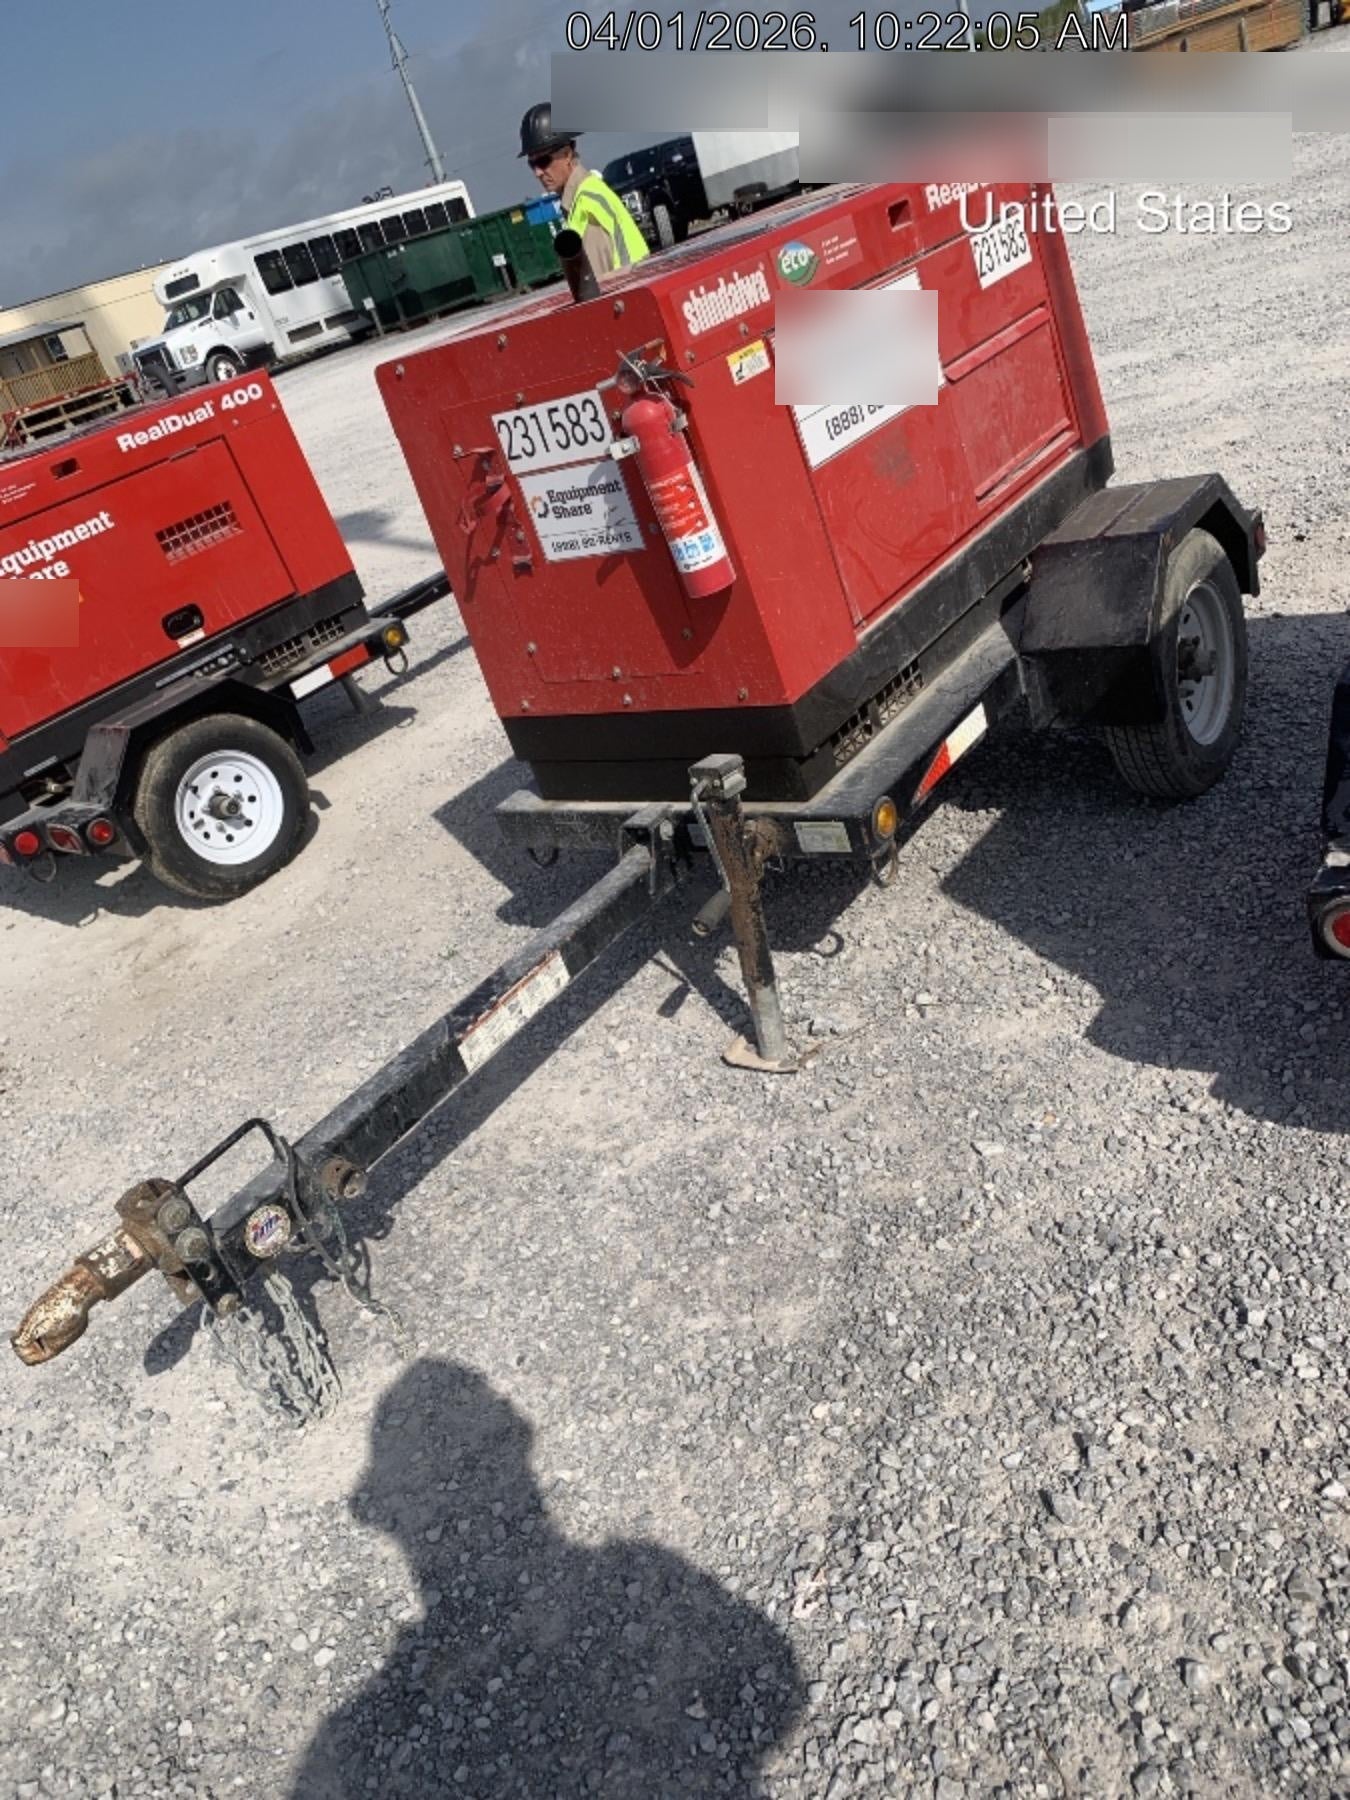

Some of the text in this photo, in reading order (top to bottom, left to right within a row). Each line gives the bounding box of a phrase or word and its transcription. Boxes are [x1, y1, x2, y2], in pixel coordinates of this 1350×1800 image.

[973, 217, 1028, 277] 231583
[682, 270, 771, 336] shindaiwa
[116, 383, 263, 452] RealDual 400
[497, 398, 606, 461] 231583
[825, 404, 865, 440] (888)
[546, 480, 623, 505] Equipment
[551, 503, 593, 519] Share
[0, 511, 115, 576] quipment
